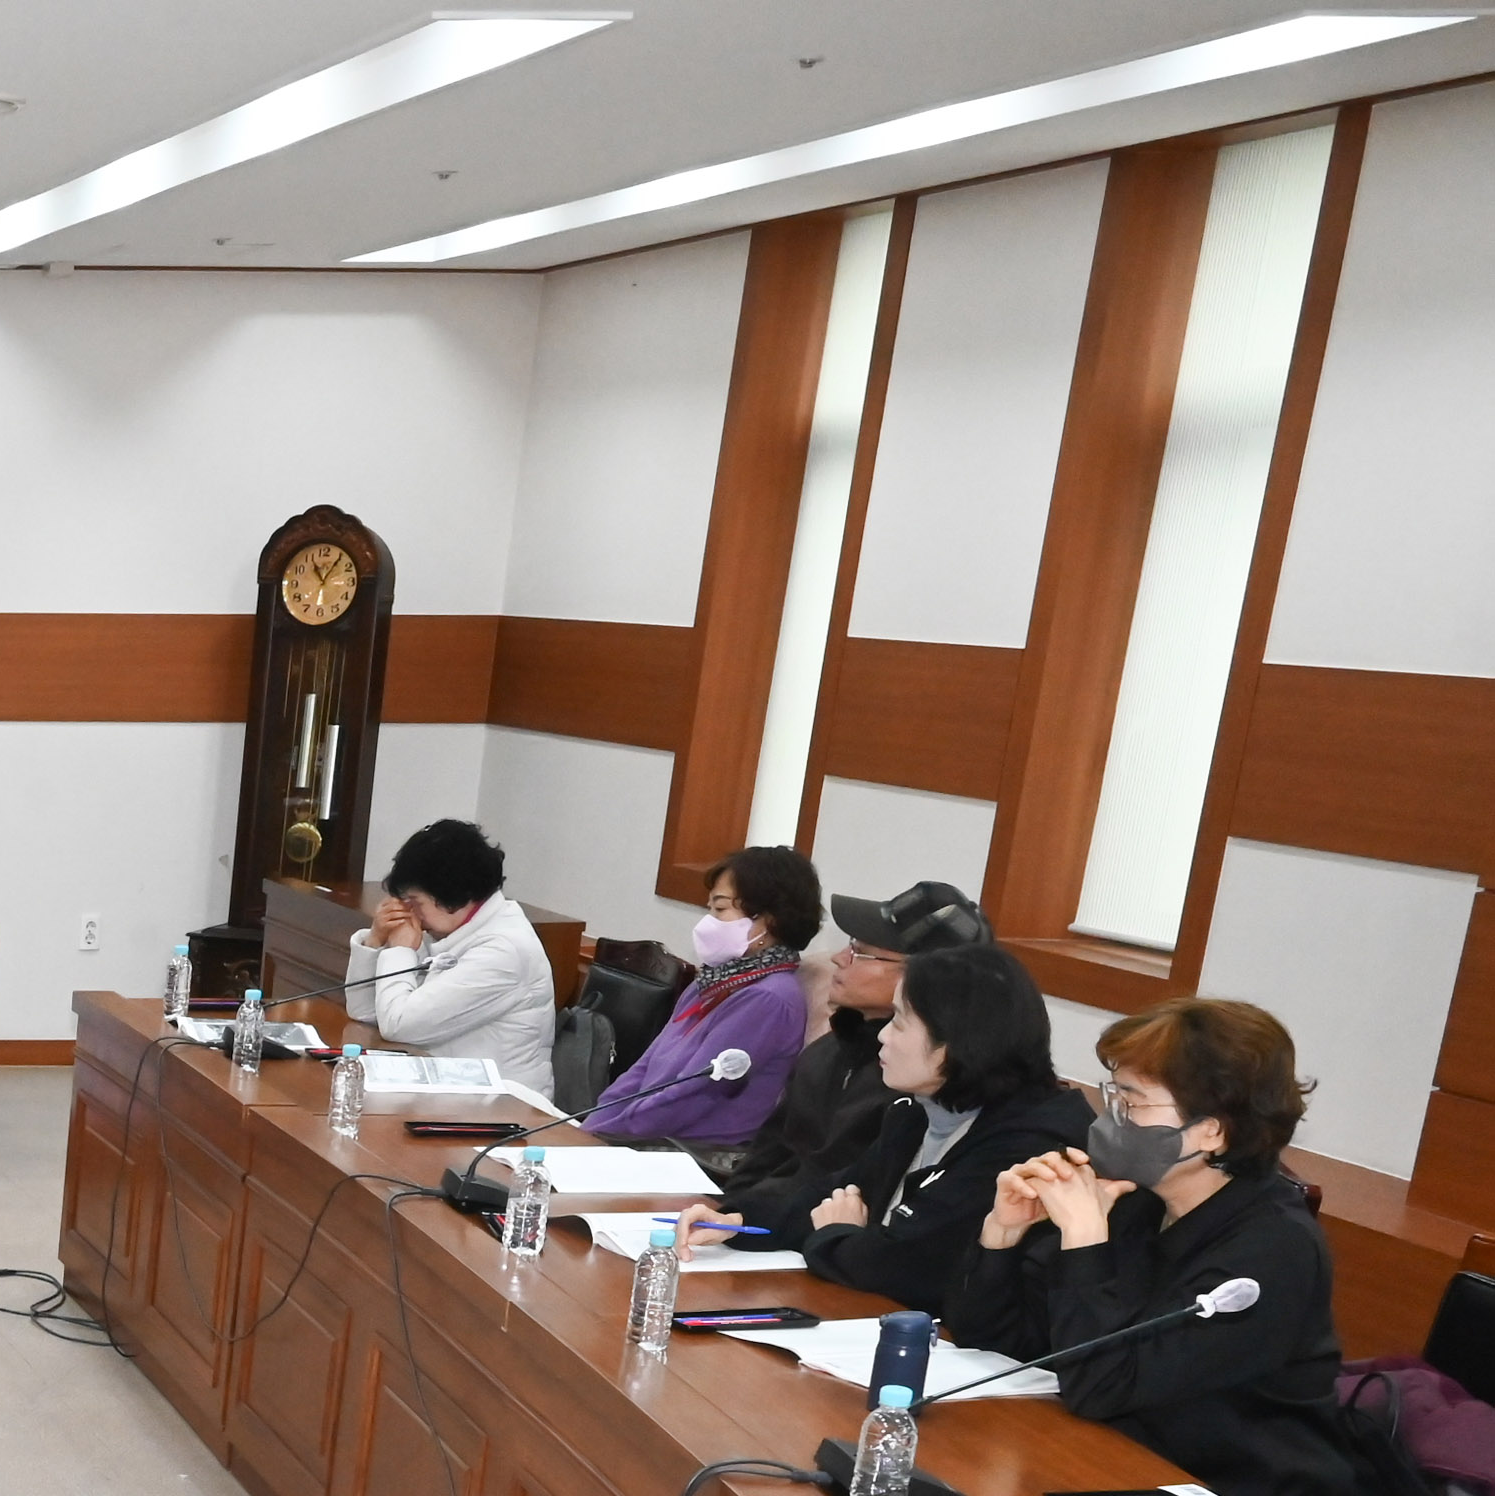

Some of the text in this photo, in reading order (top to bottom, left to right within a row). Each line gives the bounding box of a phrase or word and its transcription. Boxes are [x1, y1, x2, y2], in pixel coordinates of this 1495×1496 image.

[319, 546, 330, 557] 12
[295, 564, 305, 575] 10
[344, 562, 353, 573] 2
[291, 580, 298, 588] 9
[347, 577, 356, 587] 3
[293, 593, 302, 602] 8
[340, 592, 348, 600] 4
[302, 604, 311, 613] 7
[316, 607, 324, 617] 6
